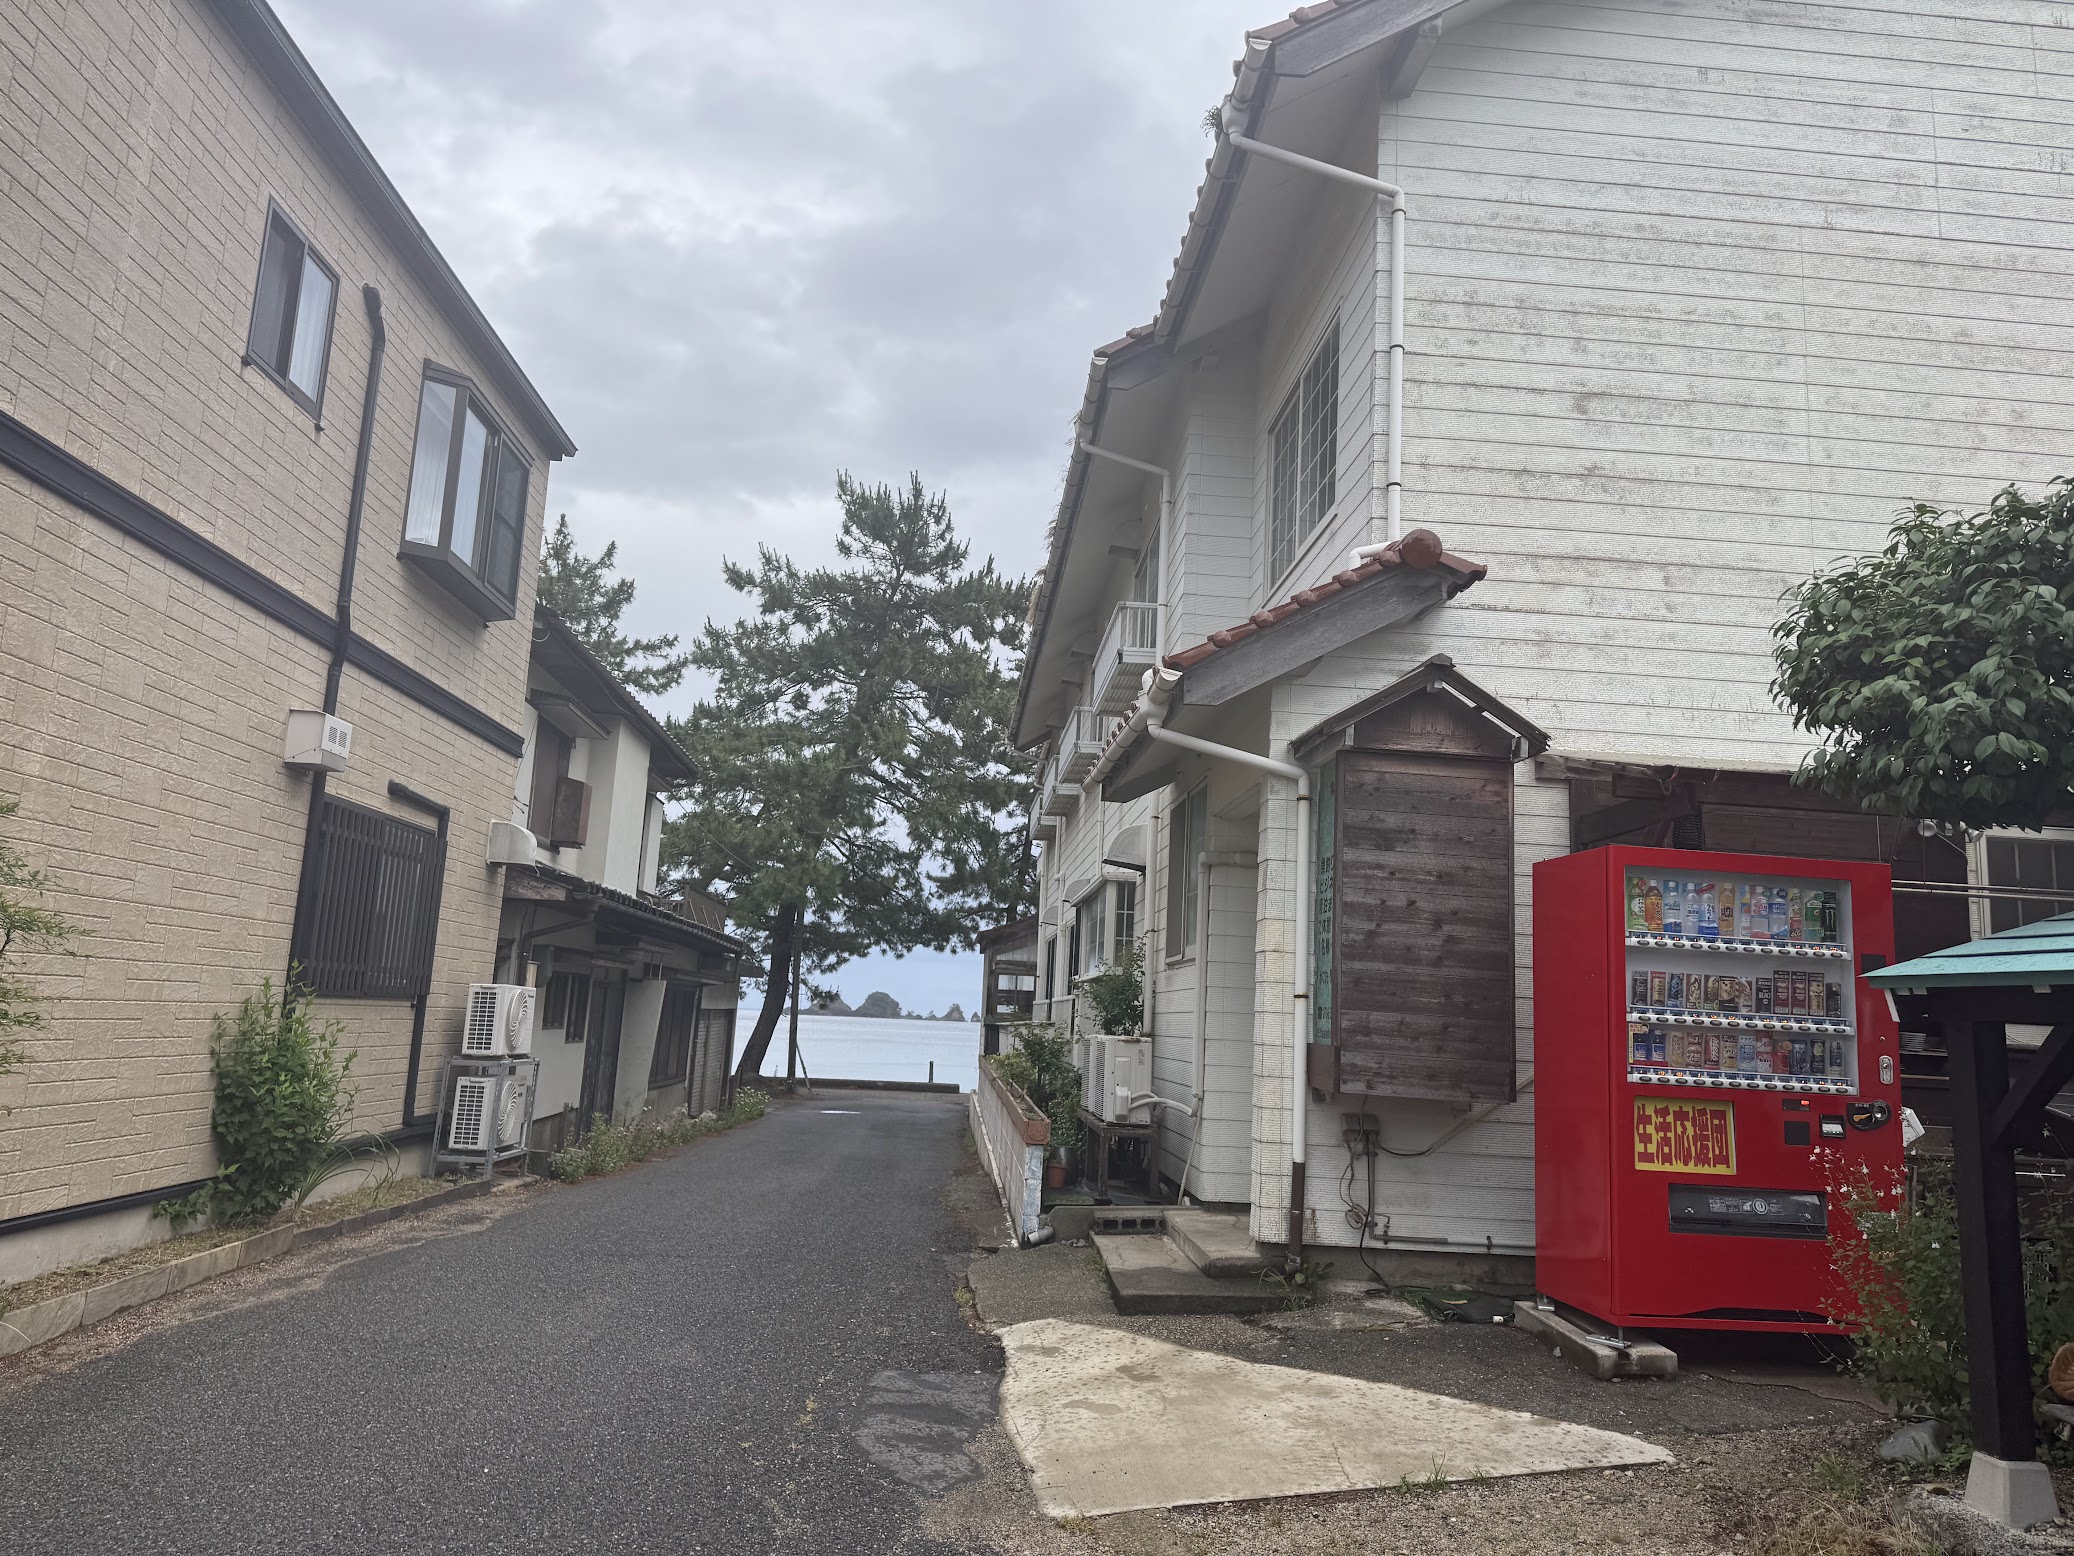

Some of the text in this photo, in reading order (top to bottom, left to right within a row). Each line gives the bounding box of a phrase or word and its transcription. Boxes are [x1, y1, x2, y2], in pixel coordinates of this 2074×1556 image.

[1636, 1103, 1730, 1168] 生活応援団
